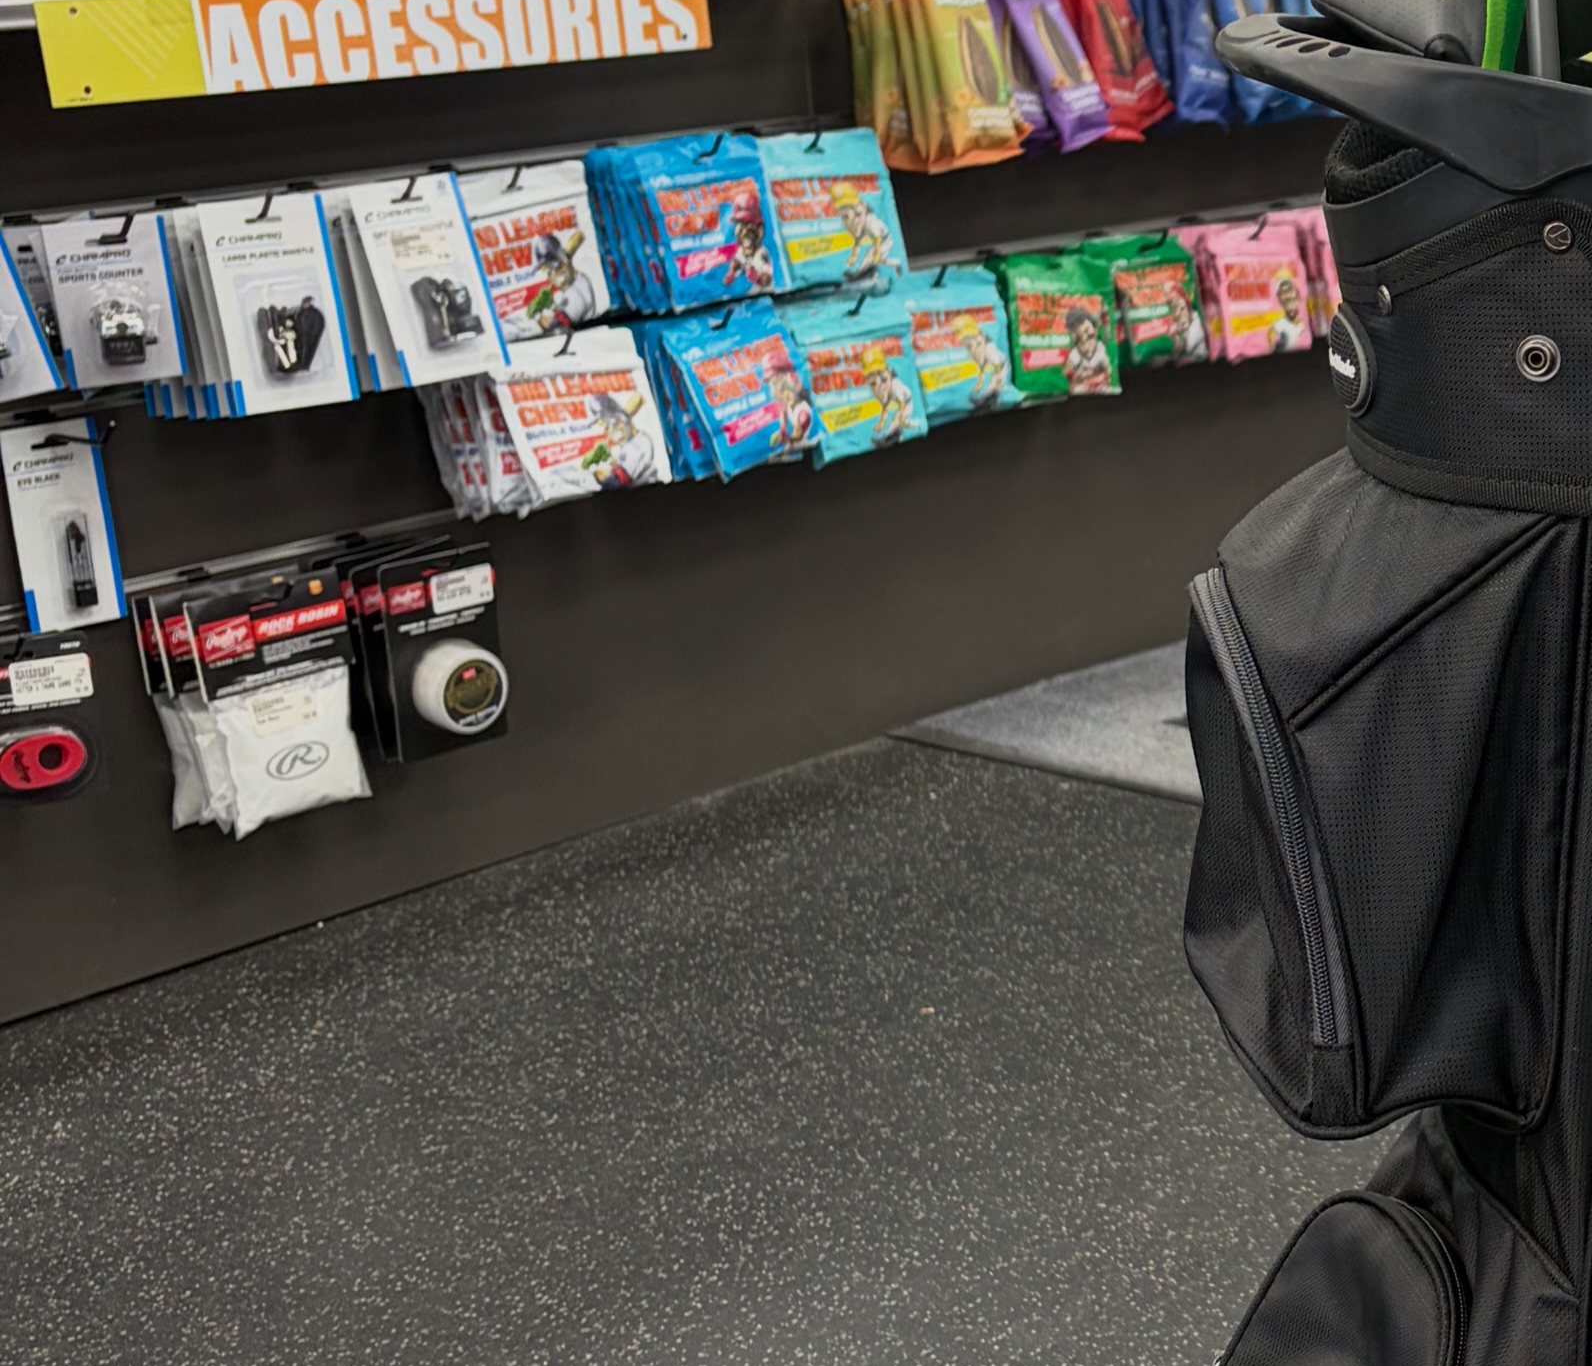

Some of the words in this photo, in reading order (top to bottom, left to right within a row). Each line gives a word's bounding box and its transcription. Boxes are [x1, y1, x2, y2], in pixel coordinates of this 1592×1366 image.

[481, 242, 533, 276] HEW
[516, 401, 588, 428] CHEW
[259, 615, 296, 635] ROCK
[297, 605, 339, 625] ROSIN
